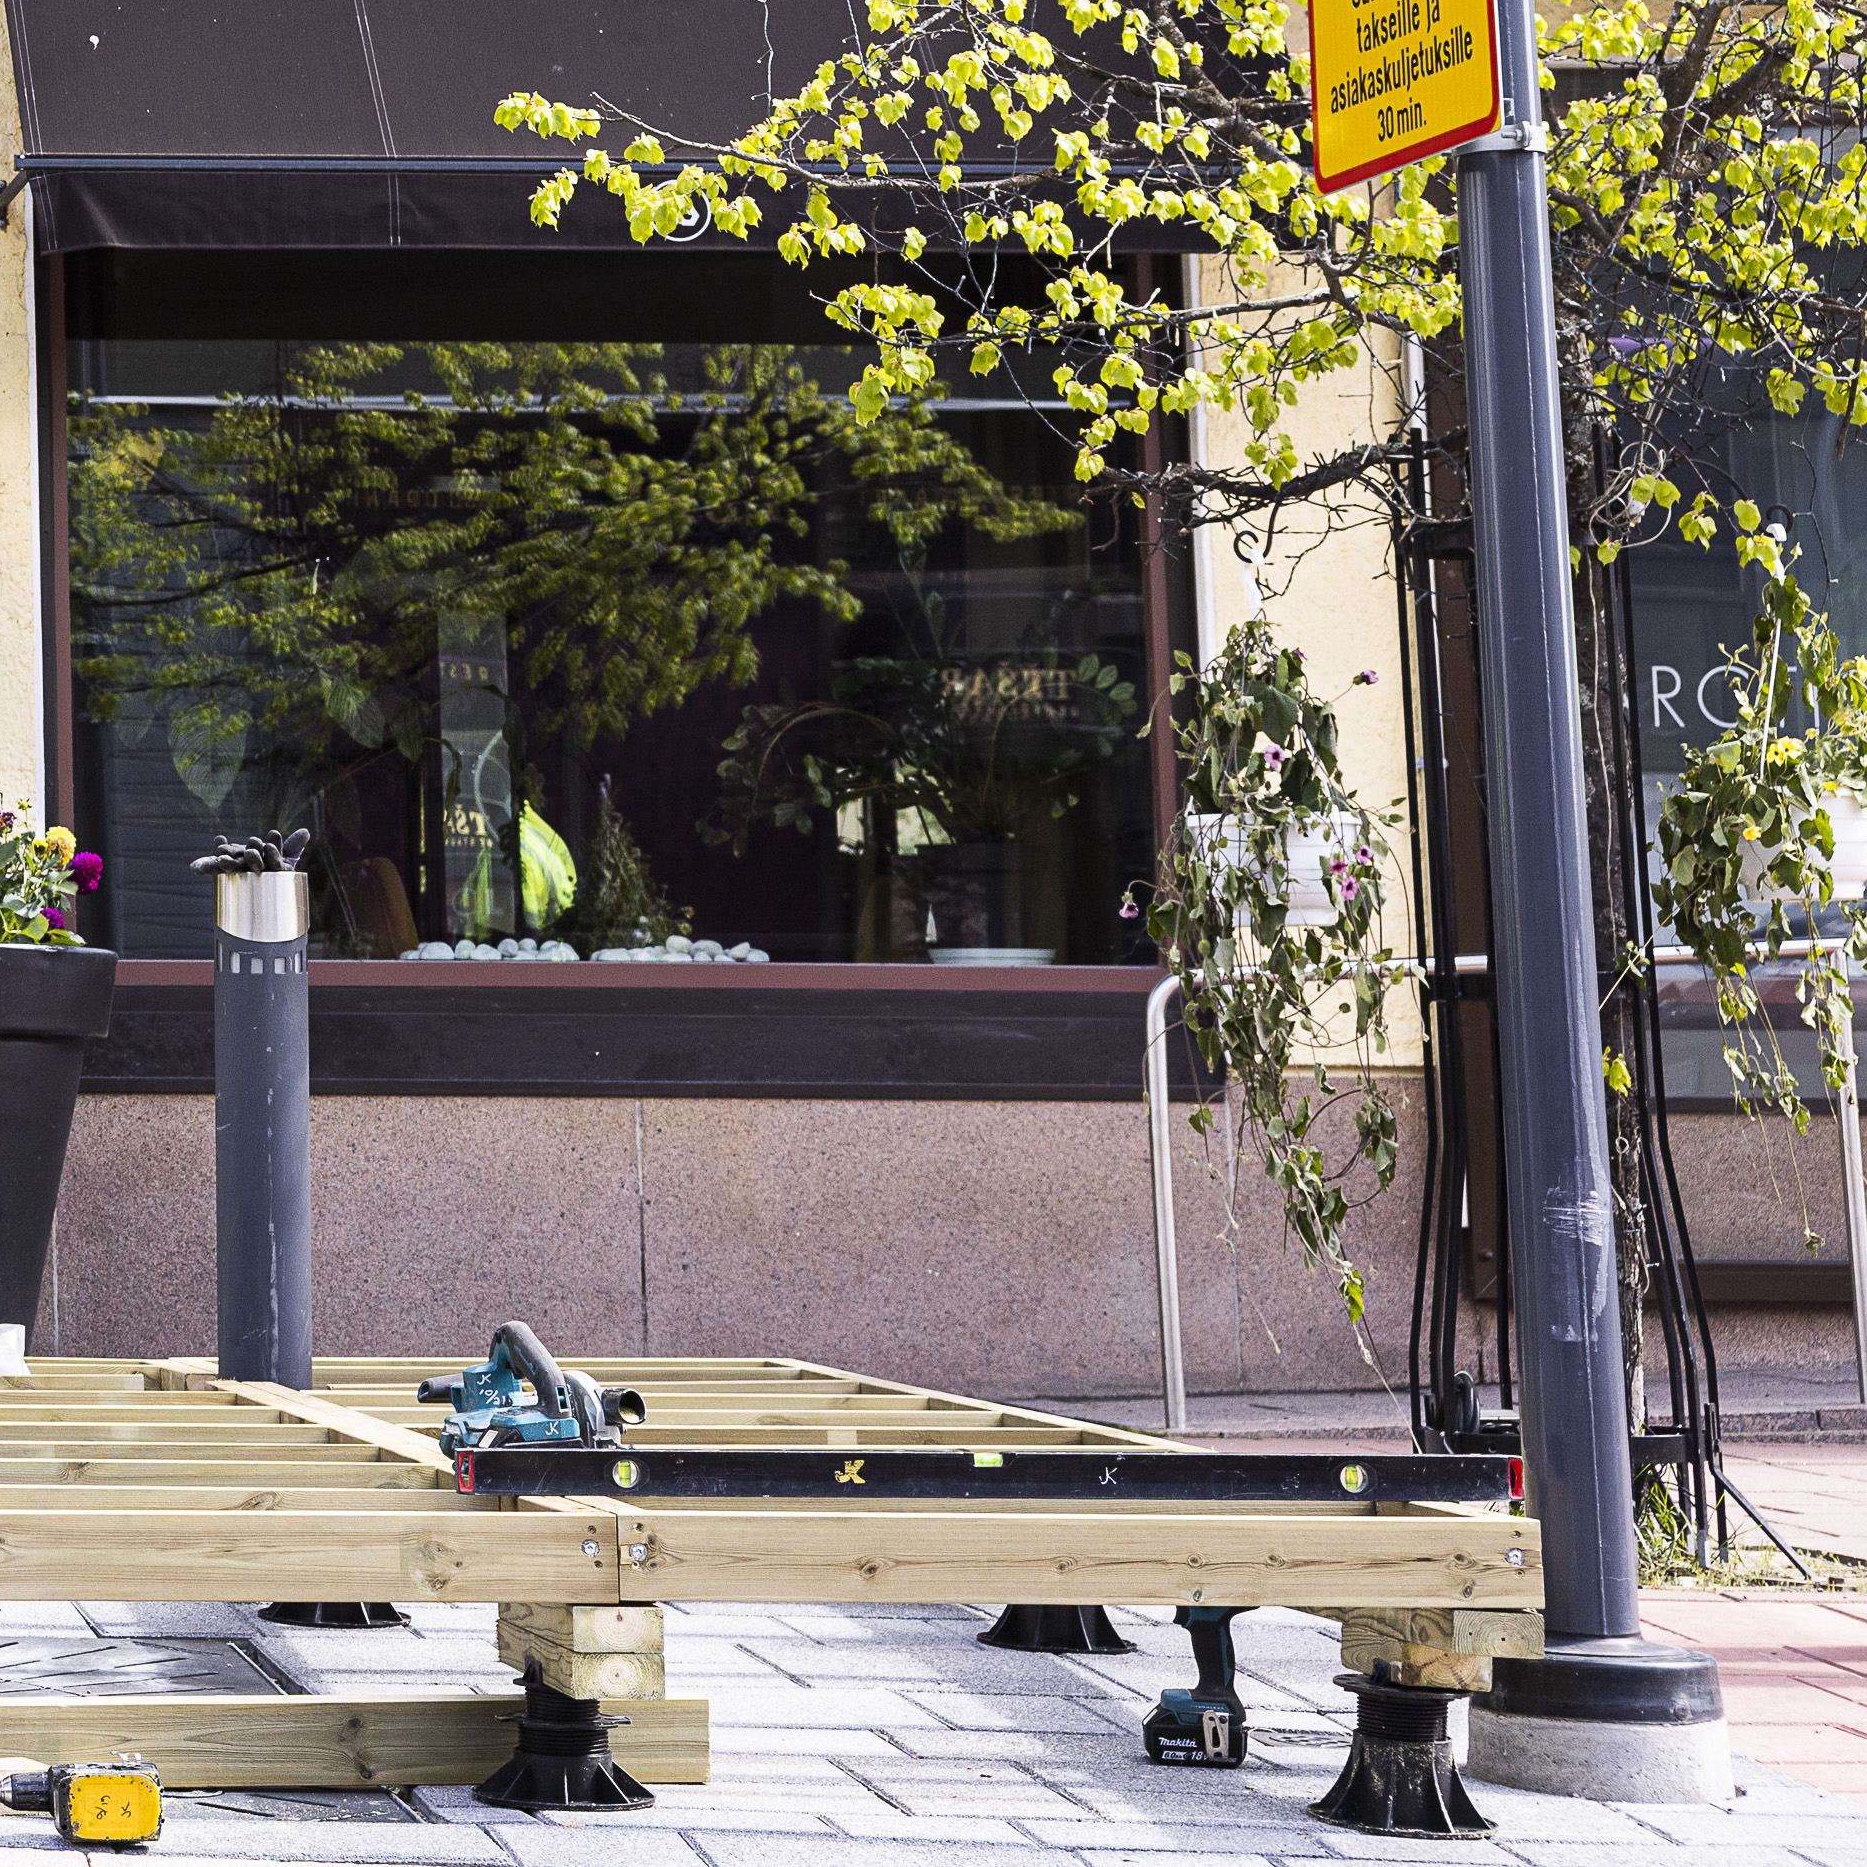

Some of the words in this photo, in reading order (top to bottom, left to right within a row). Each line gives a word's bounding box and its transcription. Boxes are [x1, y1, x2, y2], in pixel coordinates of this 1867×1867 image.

[1330, 25, 1473, 114] asiakaskuljetuksille
[1377, 106, 1394, 142] 30
[1397, 97, 1427, 135] min.
[476, 1373, 492, 1386] JK
[545, 1421, 559, 1436] JK
